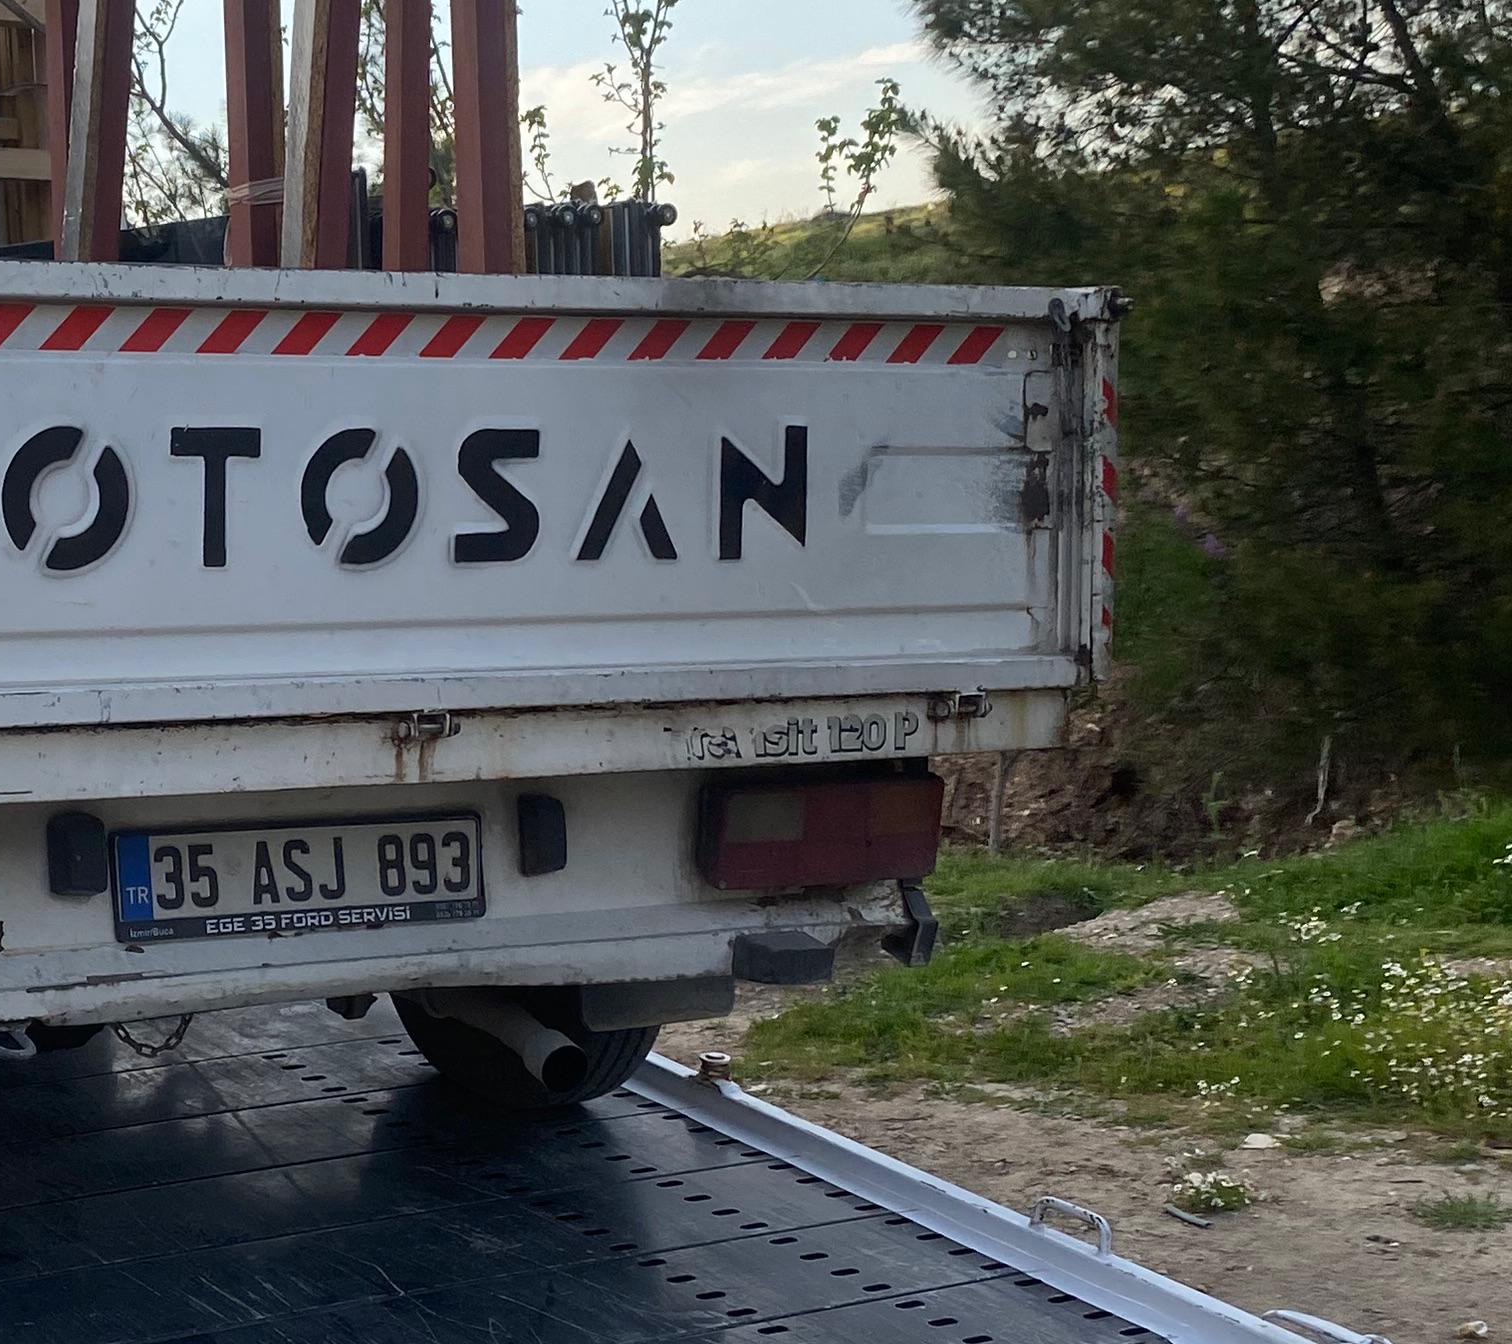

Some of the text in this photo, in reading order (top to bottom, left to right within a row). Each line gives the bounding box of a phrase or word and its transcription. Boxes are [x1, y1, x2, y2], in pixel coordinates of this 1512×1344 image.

[1, 424, 808, 571] OTOSAN
[827, 714, 887, 753] 120
[153, 831, 471, 910] 35 ASJ 893
[125, 886, 151, 905] TR
[205, 918, 246, 935] EGE
[251, 915, 276, 931] 35
[281, 912, 334, 929] FORD
